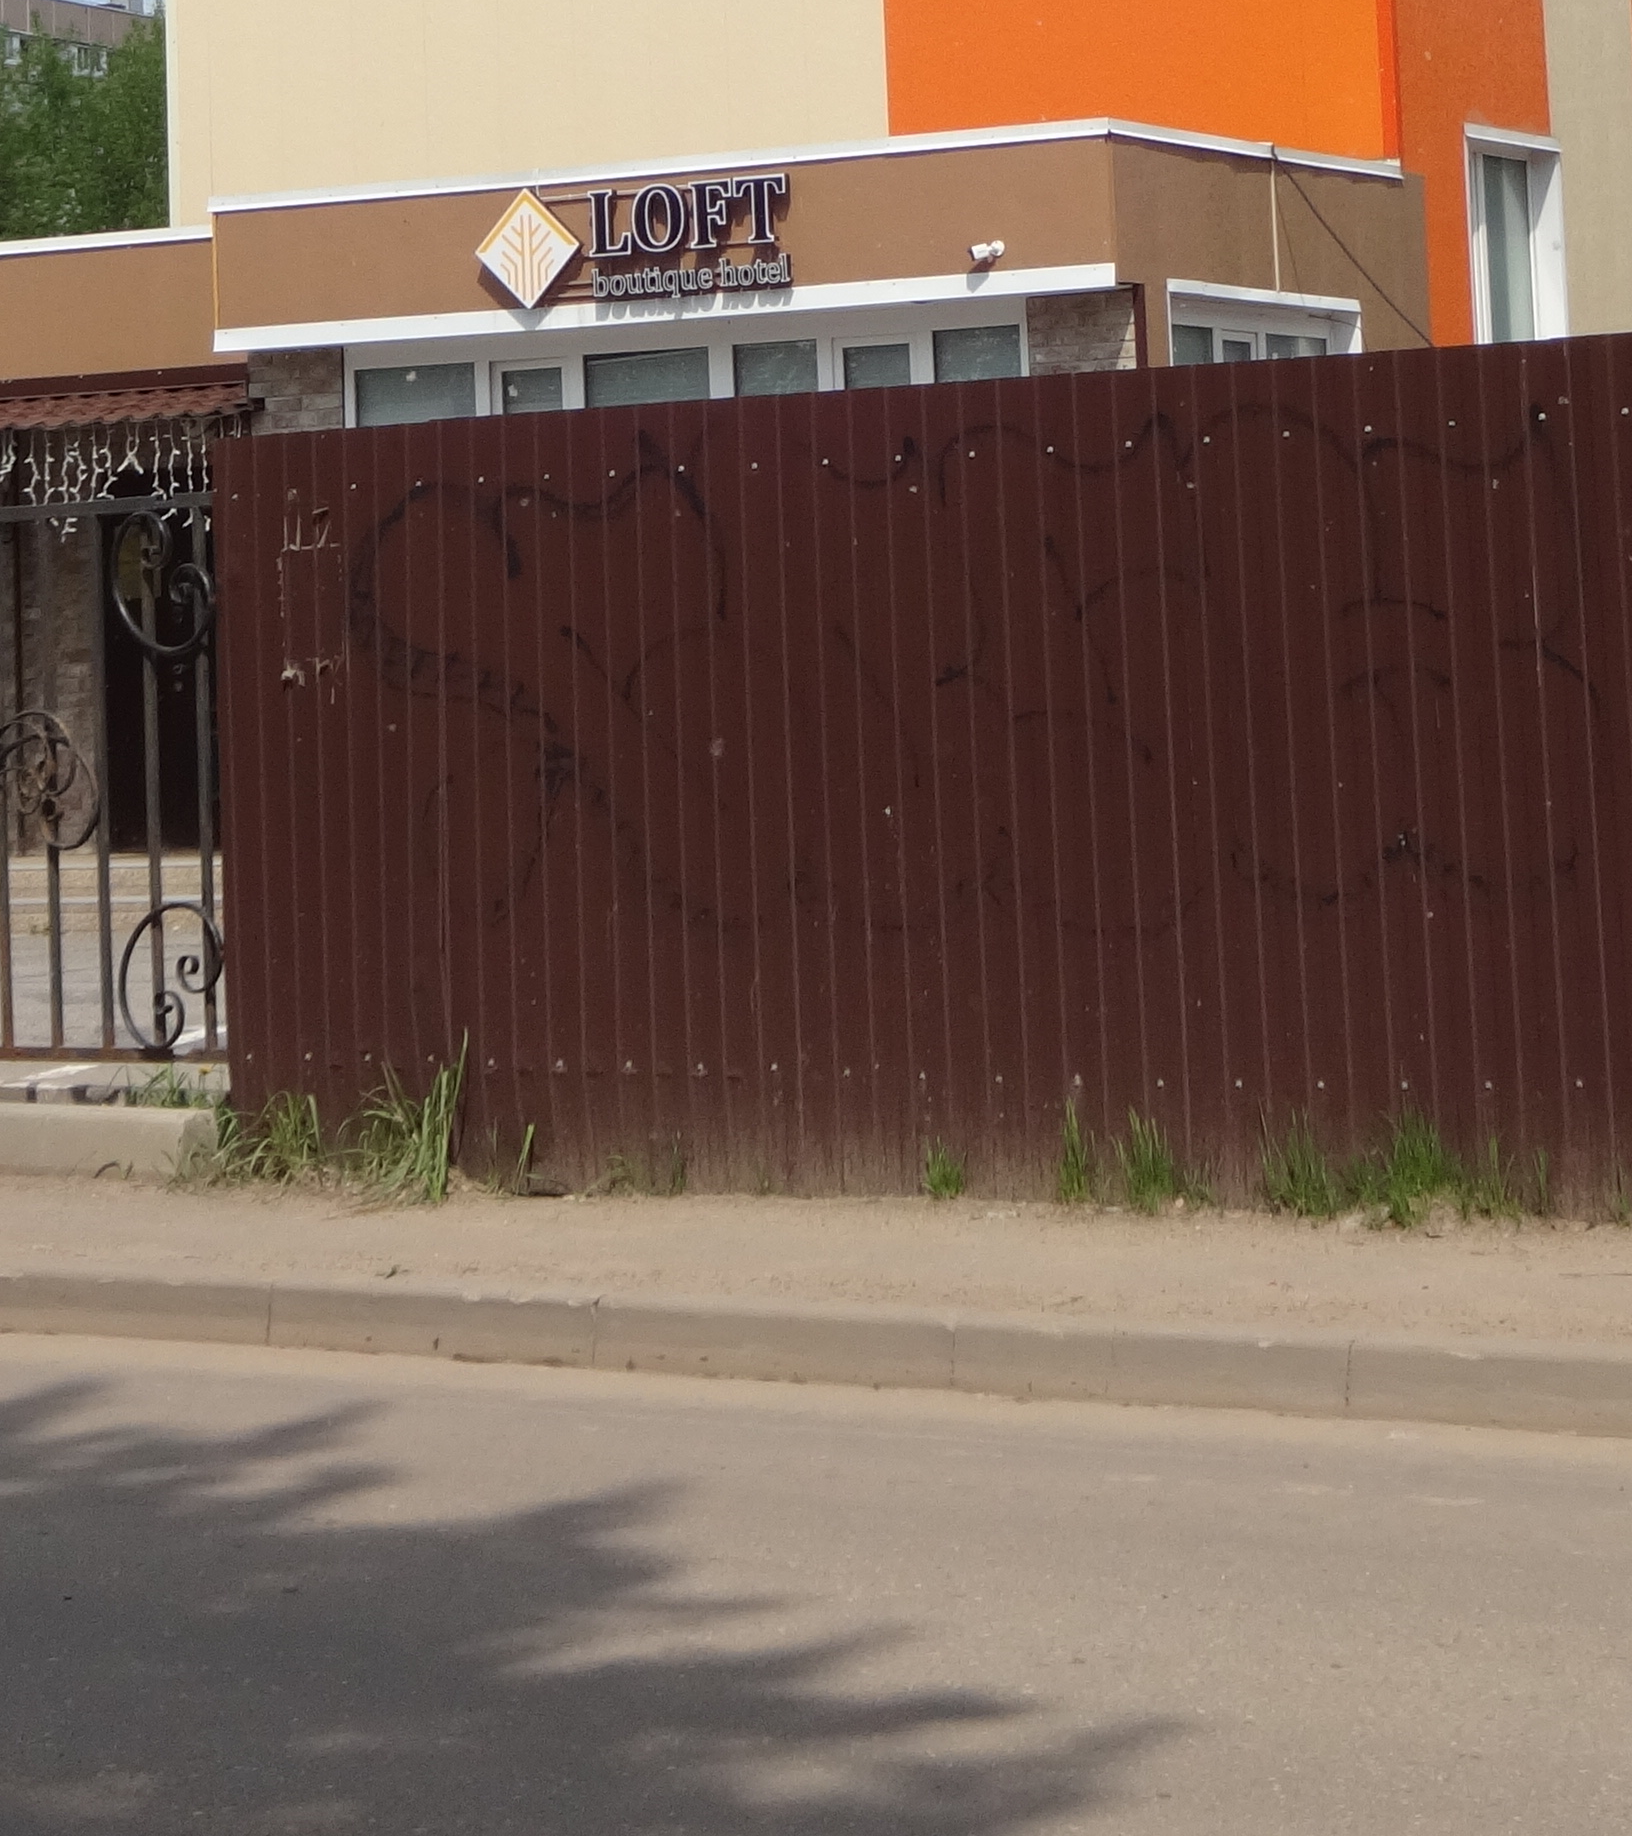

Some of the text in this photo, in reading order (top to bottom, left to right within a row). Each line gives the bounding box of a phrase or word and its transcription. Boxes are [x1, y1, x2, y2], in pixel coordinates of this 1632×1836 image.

[587, 173, 788, 258] LOFT
[591, 253, 791, 298] boutique hotel
